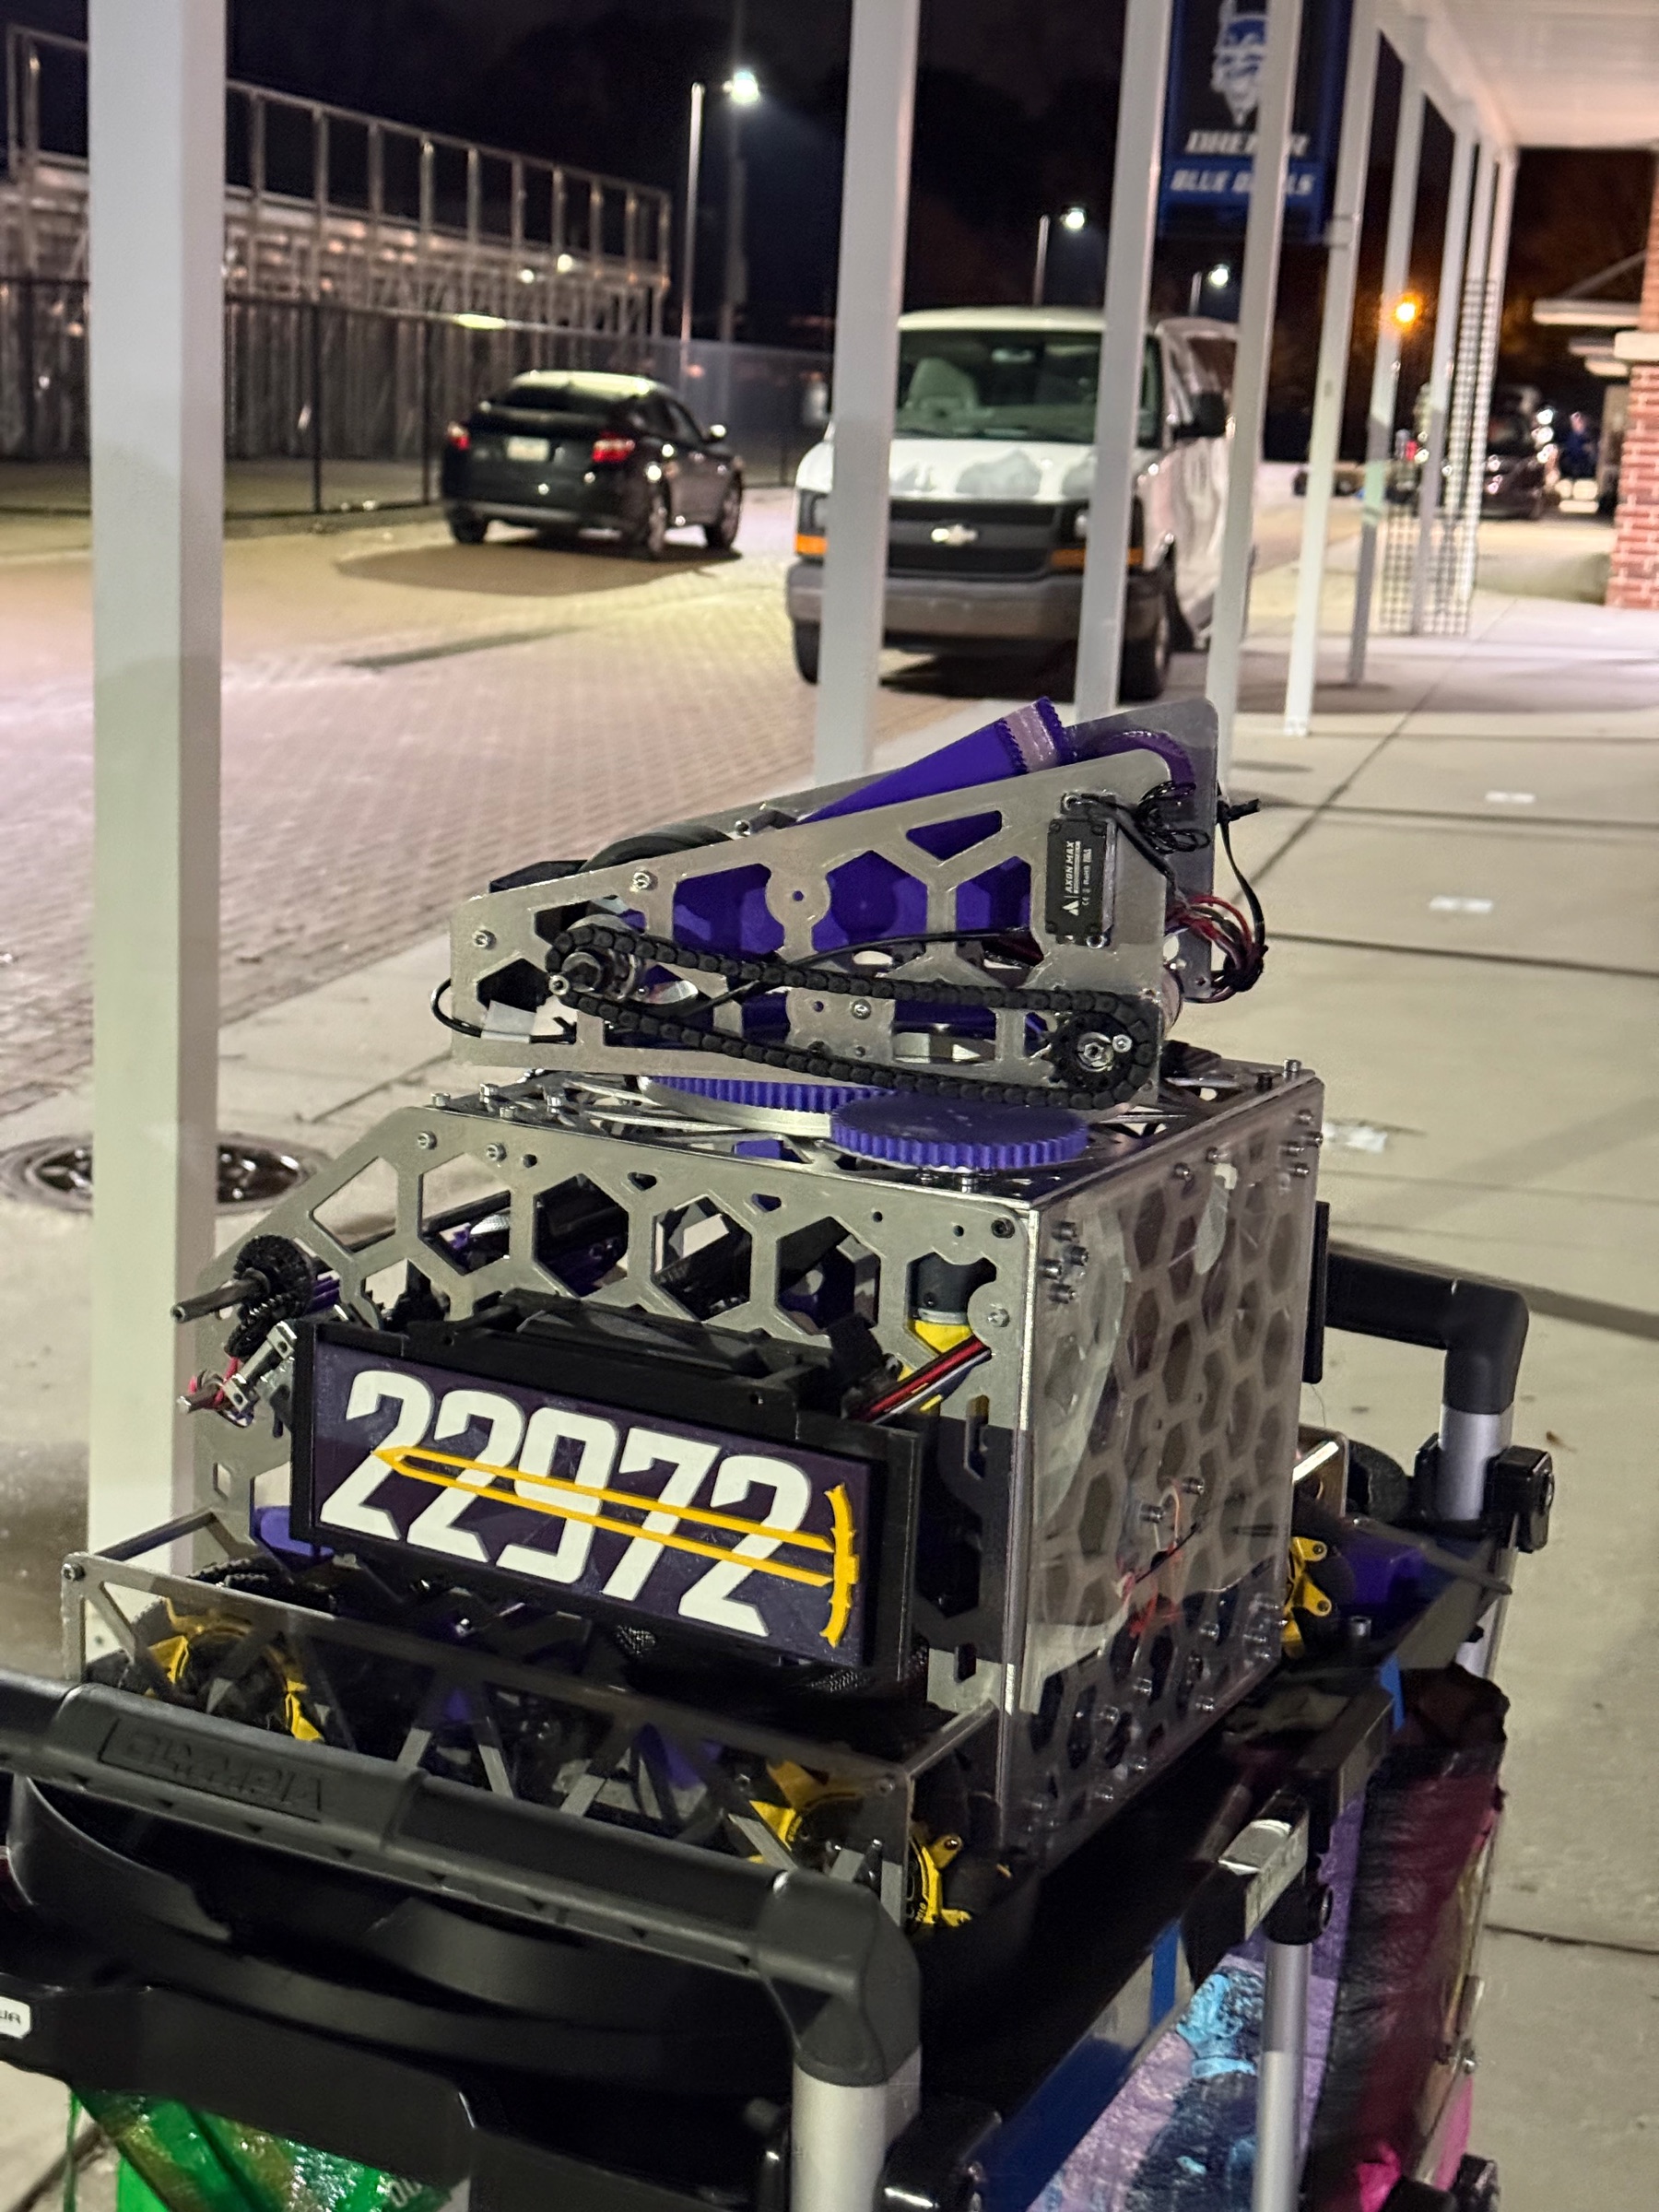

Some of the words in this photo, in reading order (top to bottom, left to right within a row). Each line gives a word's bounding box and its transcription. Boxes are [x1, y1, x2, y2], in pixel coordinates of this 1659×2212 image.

[1065, 841, 1074, 865] MAX
[1065, 865, 1073, 893] AXON
[320, 1369, 812, 1638] 22972
